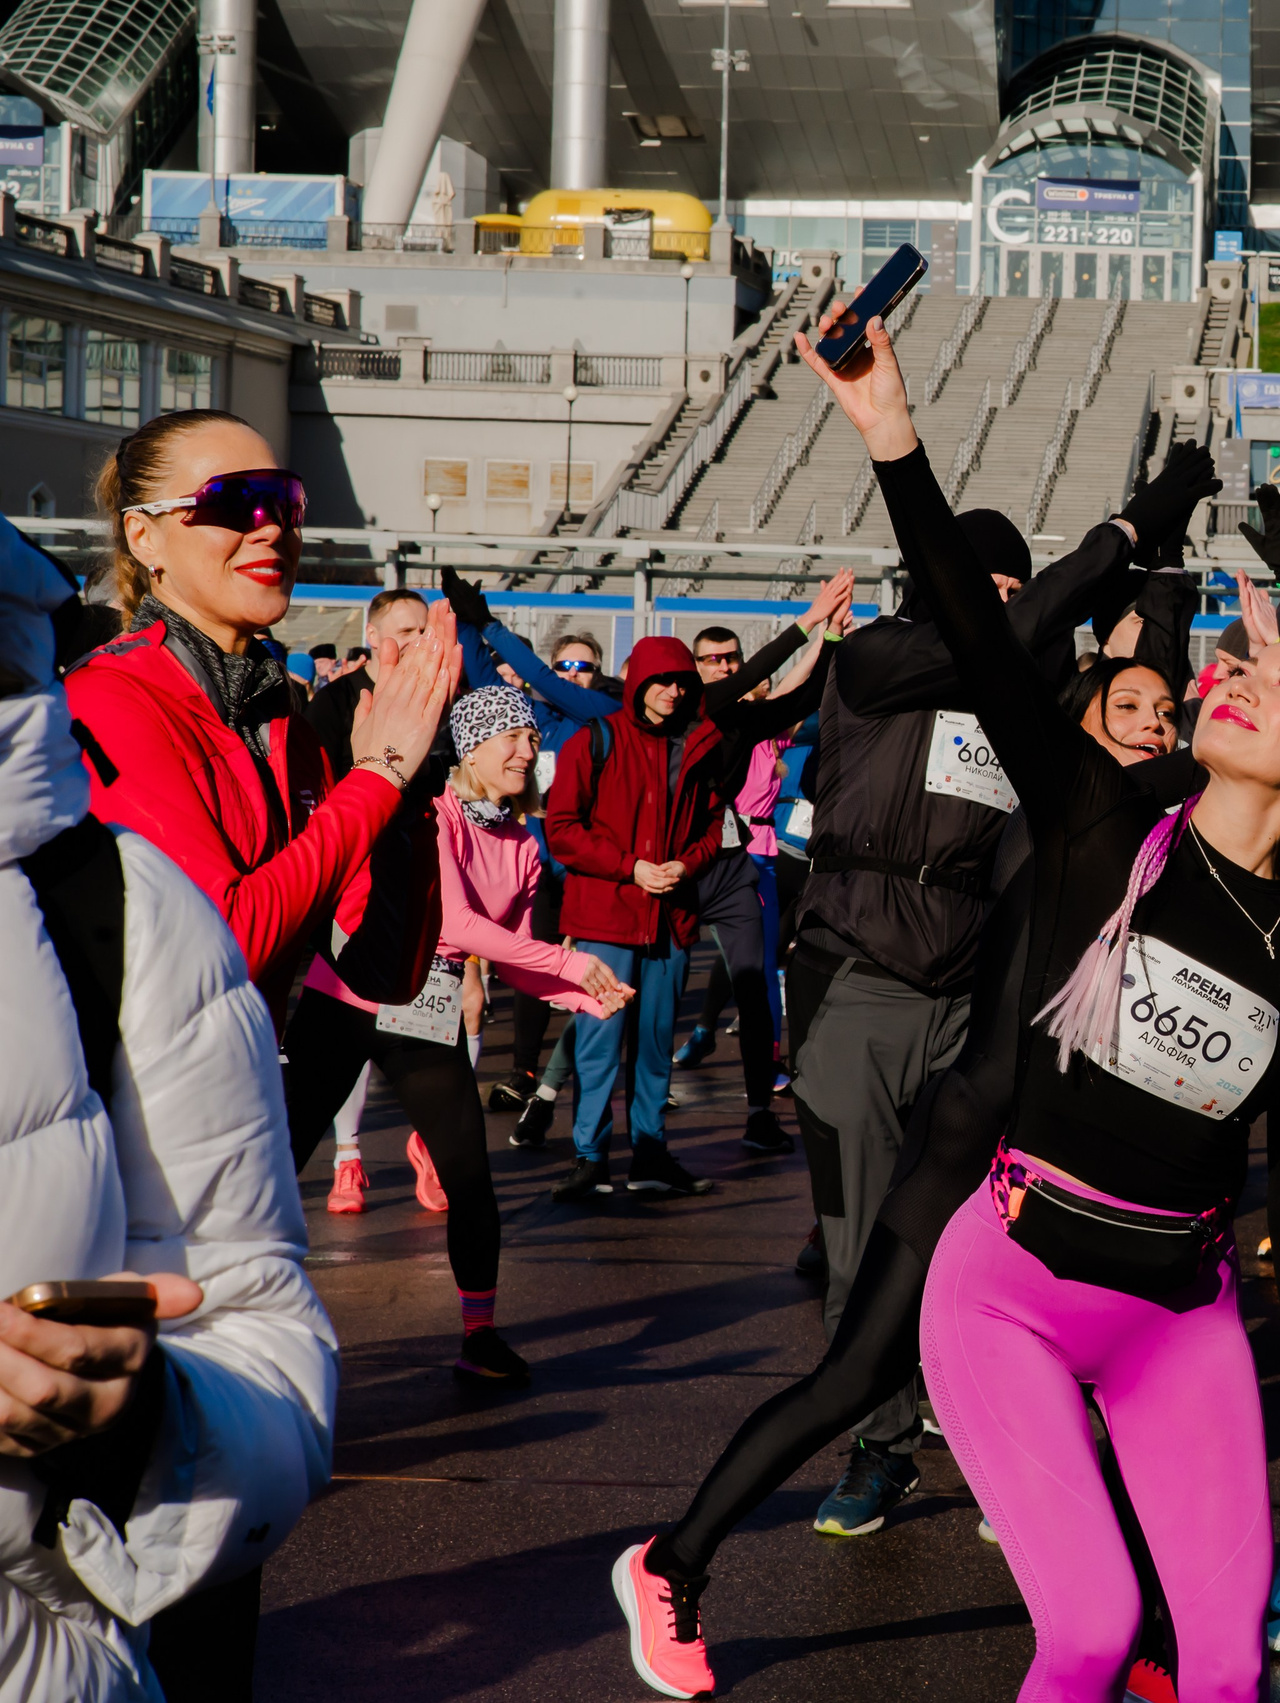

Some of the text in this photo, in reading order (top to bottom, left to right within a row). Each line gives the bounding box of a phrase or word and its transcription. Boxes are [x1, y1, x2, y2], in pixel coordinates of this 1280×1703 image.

[965, 765, 1004, 782] НИКОЛАЙ
[1171, 975, 1230, 1012] ПОЛУМАРАФОН
[1175, 967, 1233, 1006] АРЕНА
[412, 1009, 434, 1019] ОЛЬГА
[1130, 991, 1232, 1064] 6650
[1137, 1030, 1197, 1069] АЛЬФИЯ
[1216, 1078, 1244, 1097] 2025
